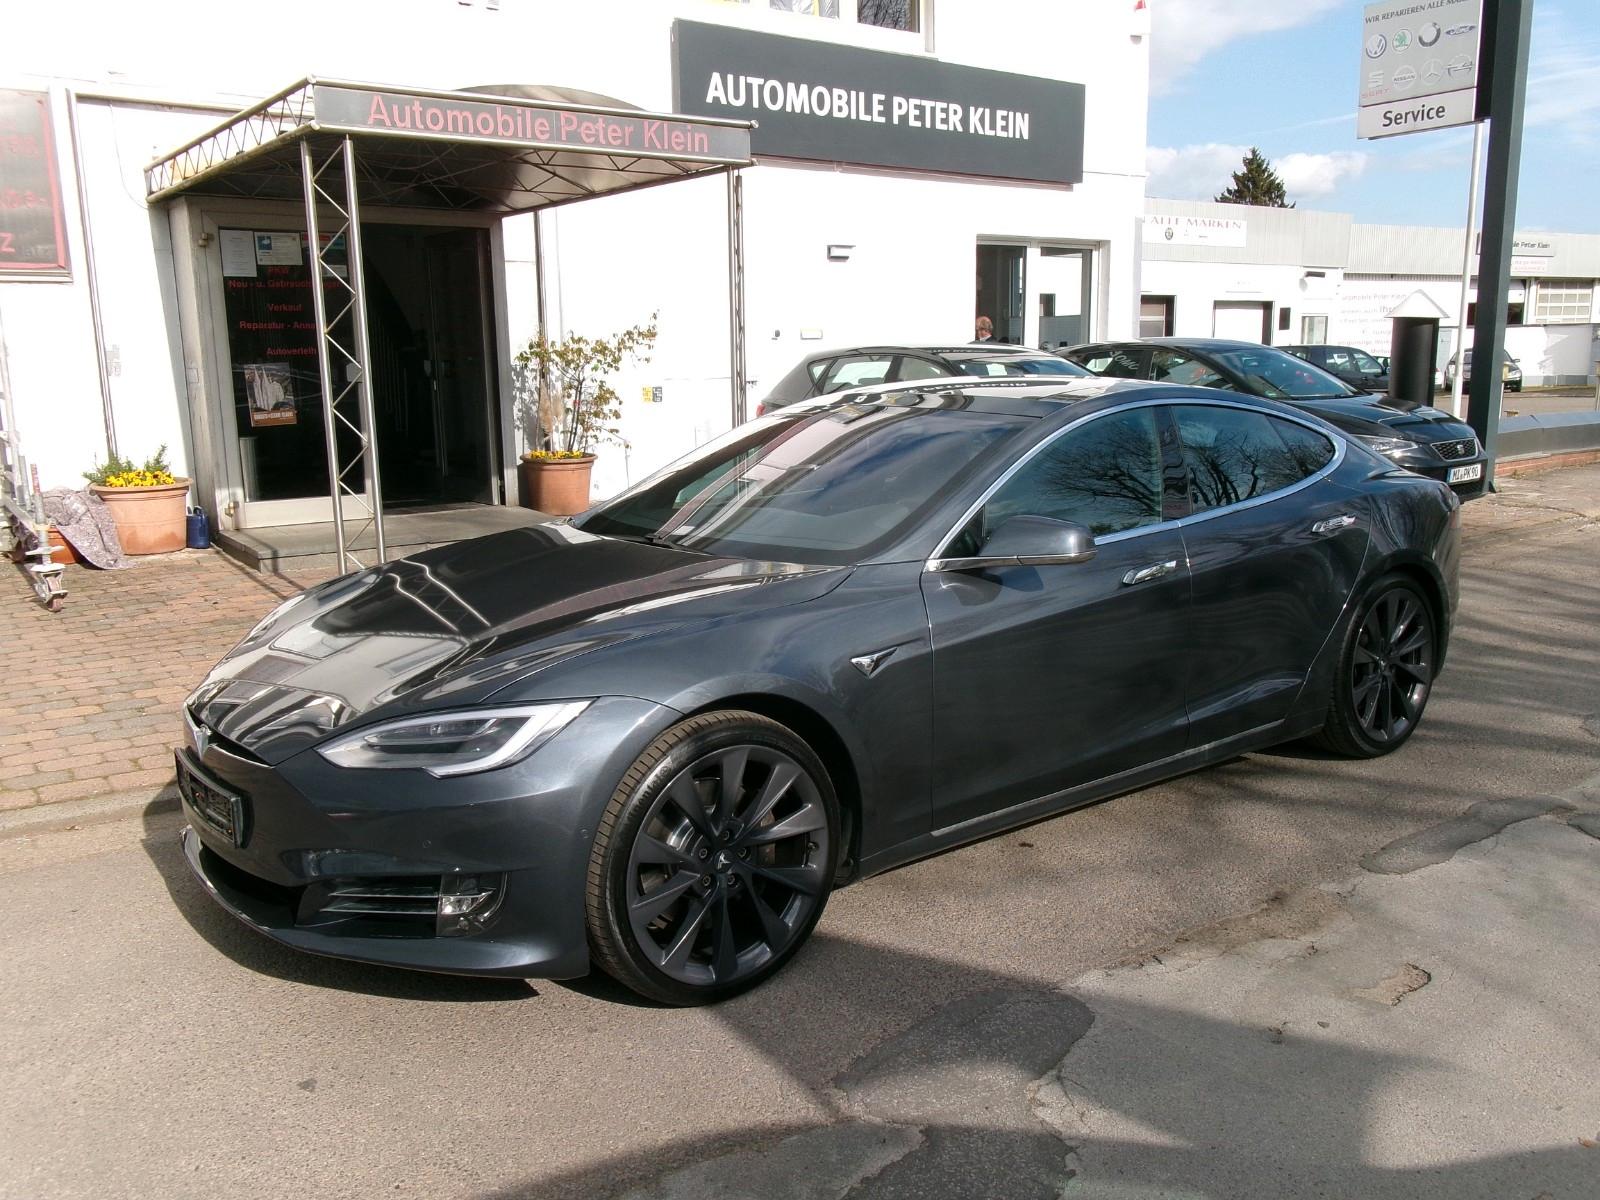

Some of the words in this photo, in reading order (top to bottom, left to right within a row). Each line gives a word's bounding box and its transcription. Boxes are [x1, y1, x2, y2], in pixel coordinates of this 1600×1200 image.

[1365, 14, 1380, 24] WIR
[1381, 6, 1426, 20] REPARIEREN
[706, 71, 886, 124] AUTOMOBILE
[892, 96, 963, 132] PETER
[968, 106, 1030, 140] KLEIN
[367, 95, 550, 140] Automobile
[560, 112, 634, 146] Peter
[643, 120, 709, 153] Klein
[1382, 104, 1446, 127] Service
[268, 303, 303, 312] Verkauf
[239, 321, 285, 331] Reparatur
[266, 347, 317, 356] Autoverleih
